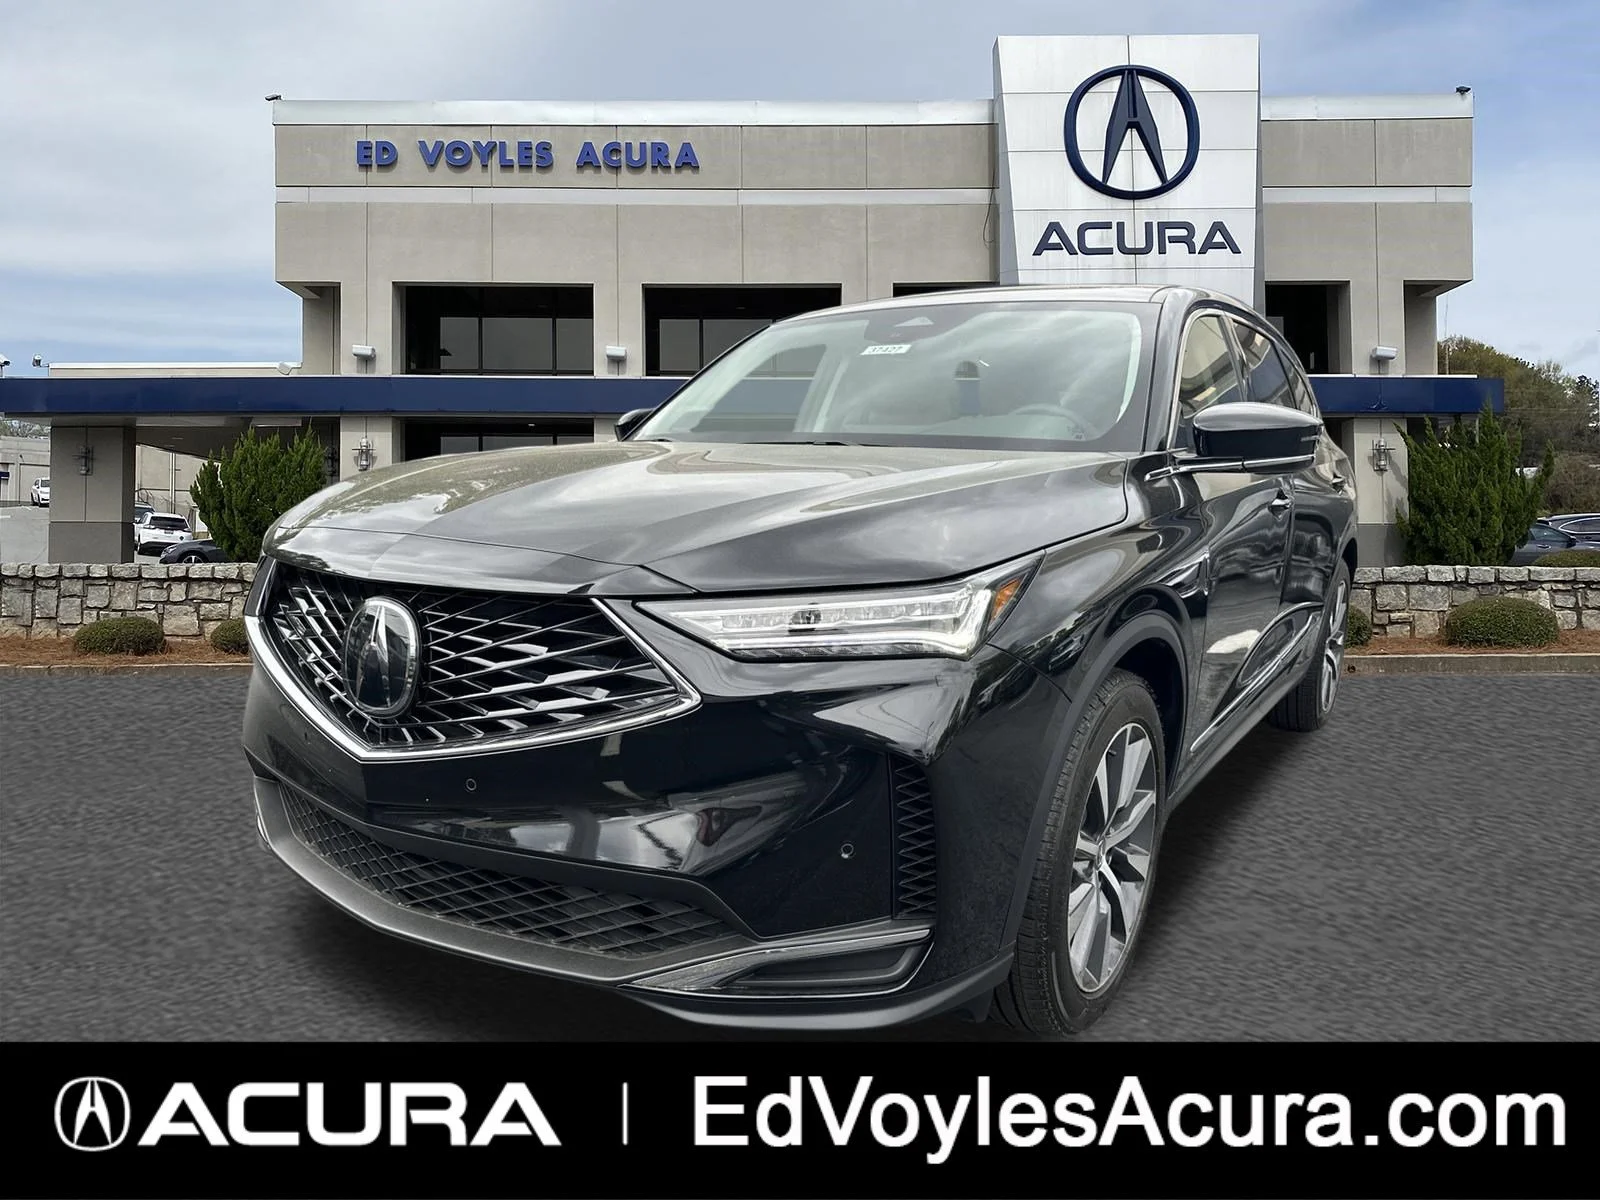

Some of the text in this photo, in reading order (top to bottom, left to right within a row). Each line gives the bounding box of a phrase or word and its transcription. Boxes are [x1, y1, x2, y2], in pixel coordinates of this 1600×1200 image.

[356, 139, 701, 169] ED VOYLES ACURA
[1032, 221, 1242, 256] ACURA
